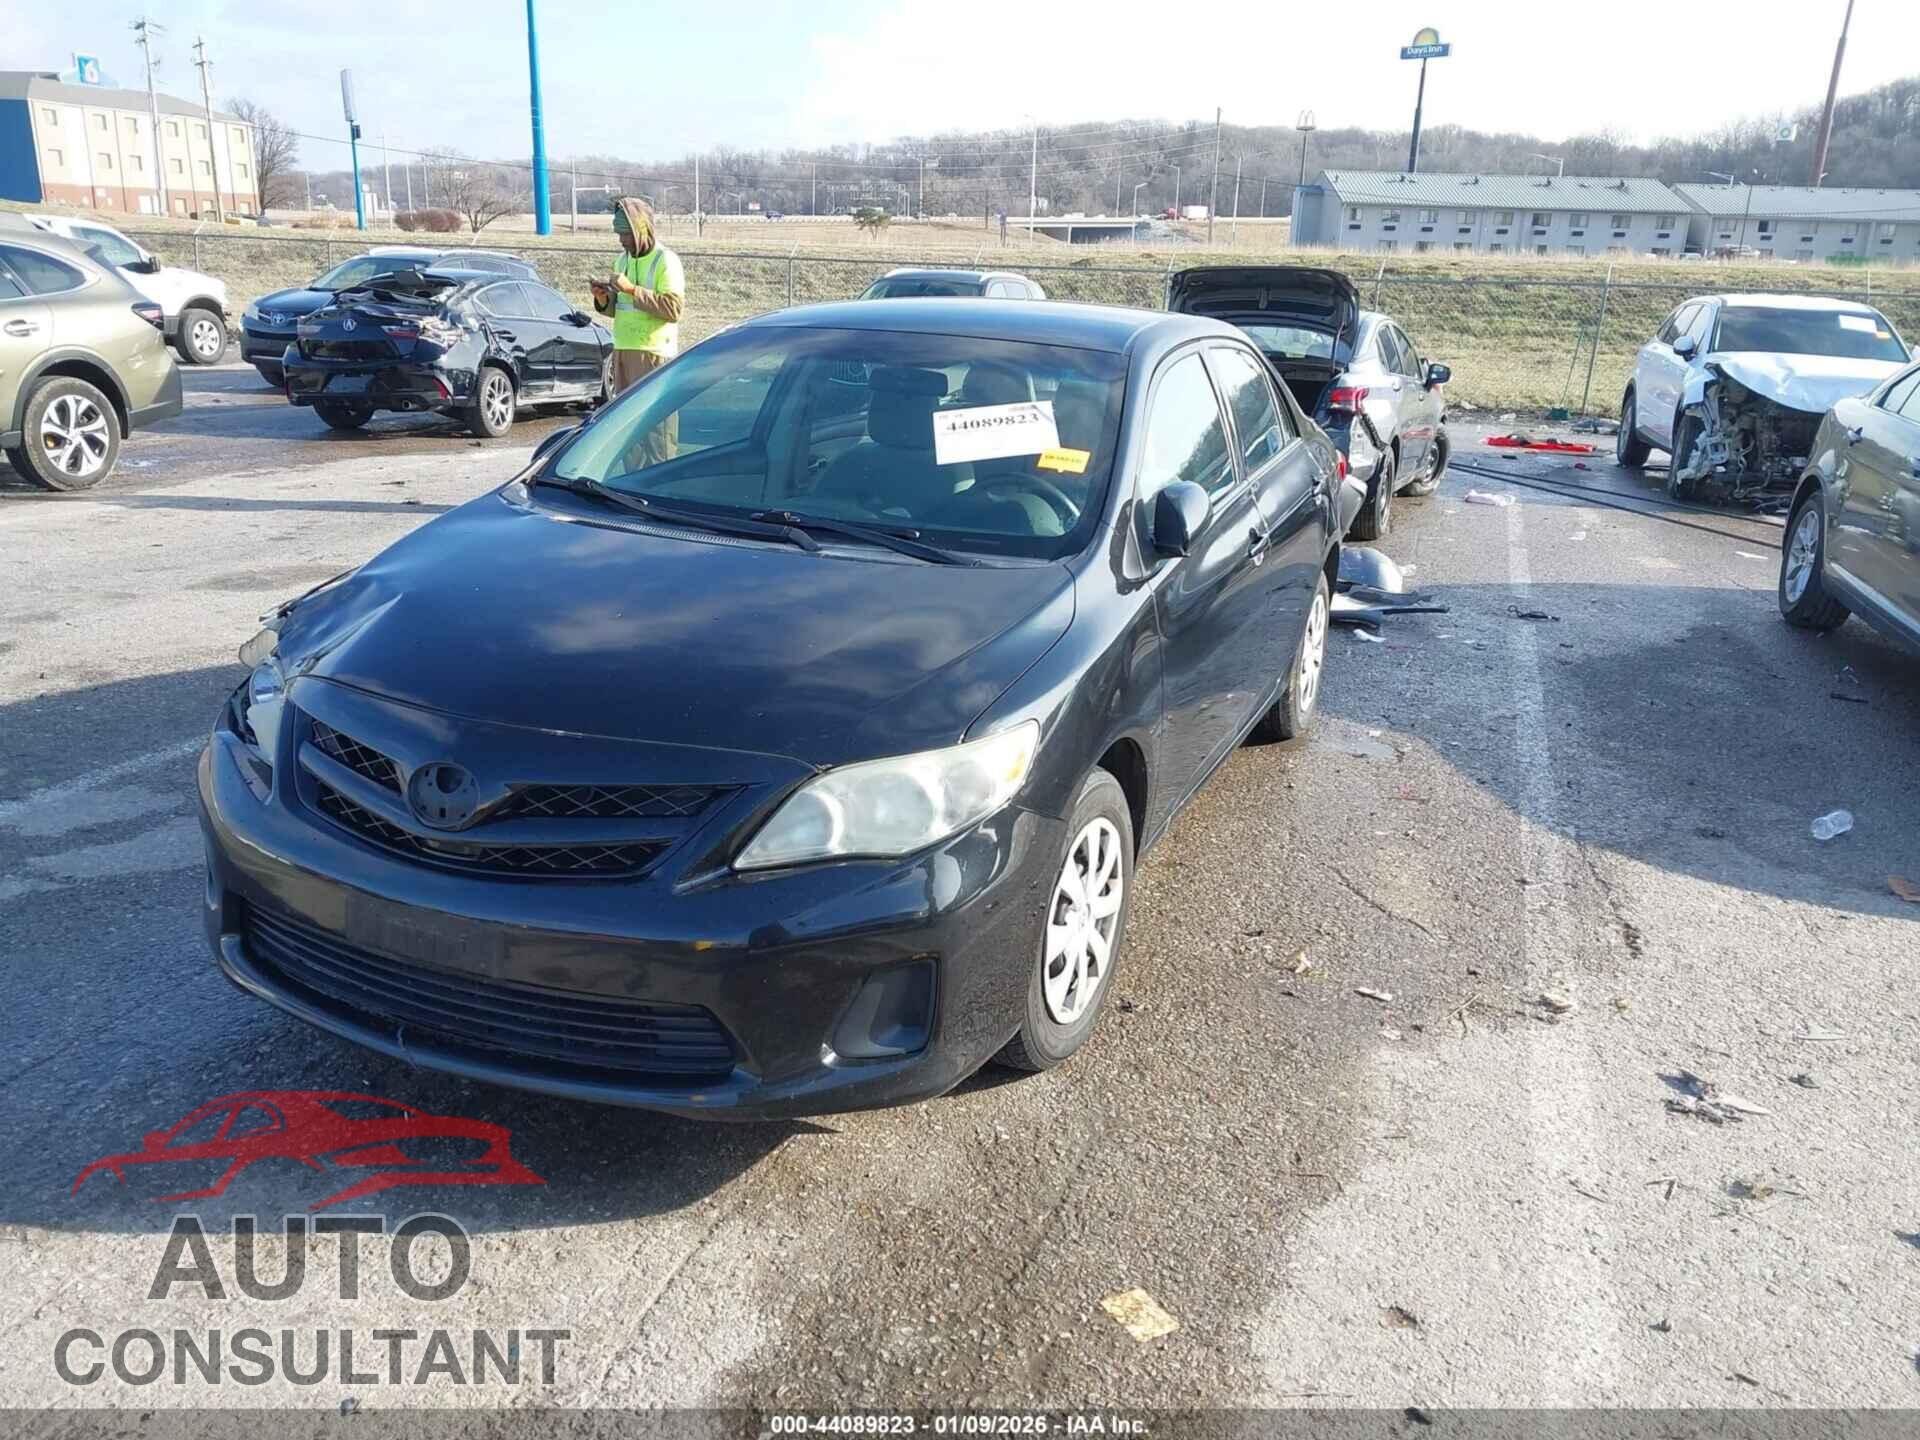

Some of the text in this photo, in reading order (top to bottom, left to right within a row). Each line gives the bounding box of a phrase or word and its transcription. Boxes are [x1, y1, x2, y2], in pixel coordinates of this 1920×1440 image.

[1407, 45, 1442, 55] Days Inn
[946, 412, 1040, 432] 44089823
